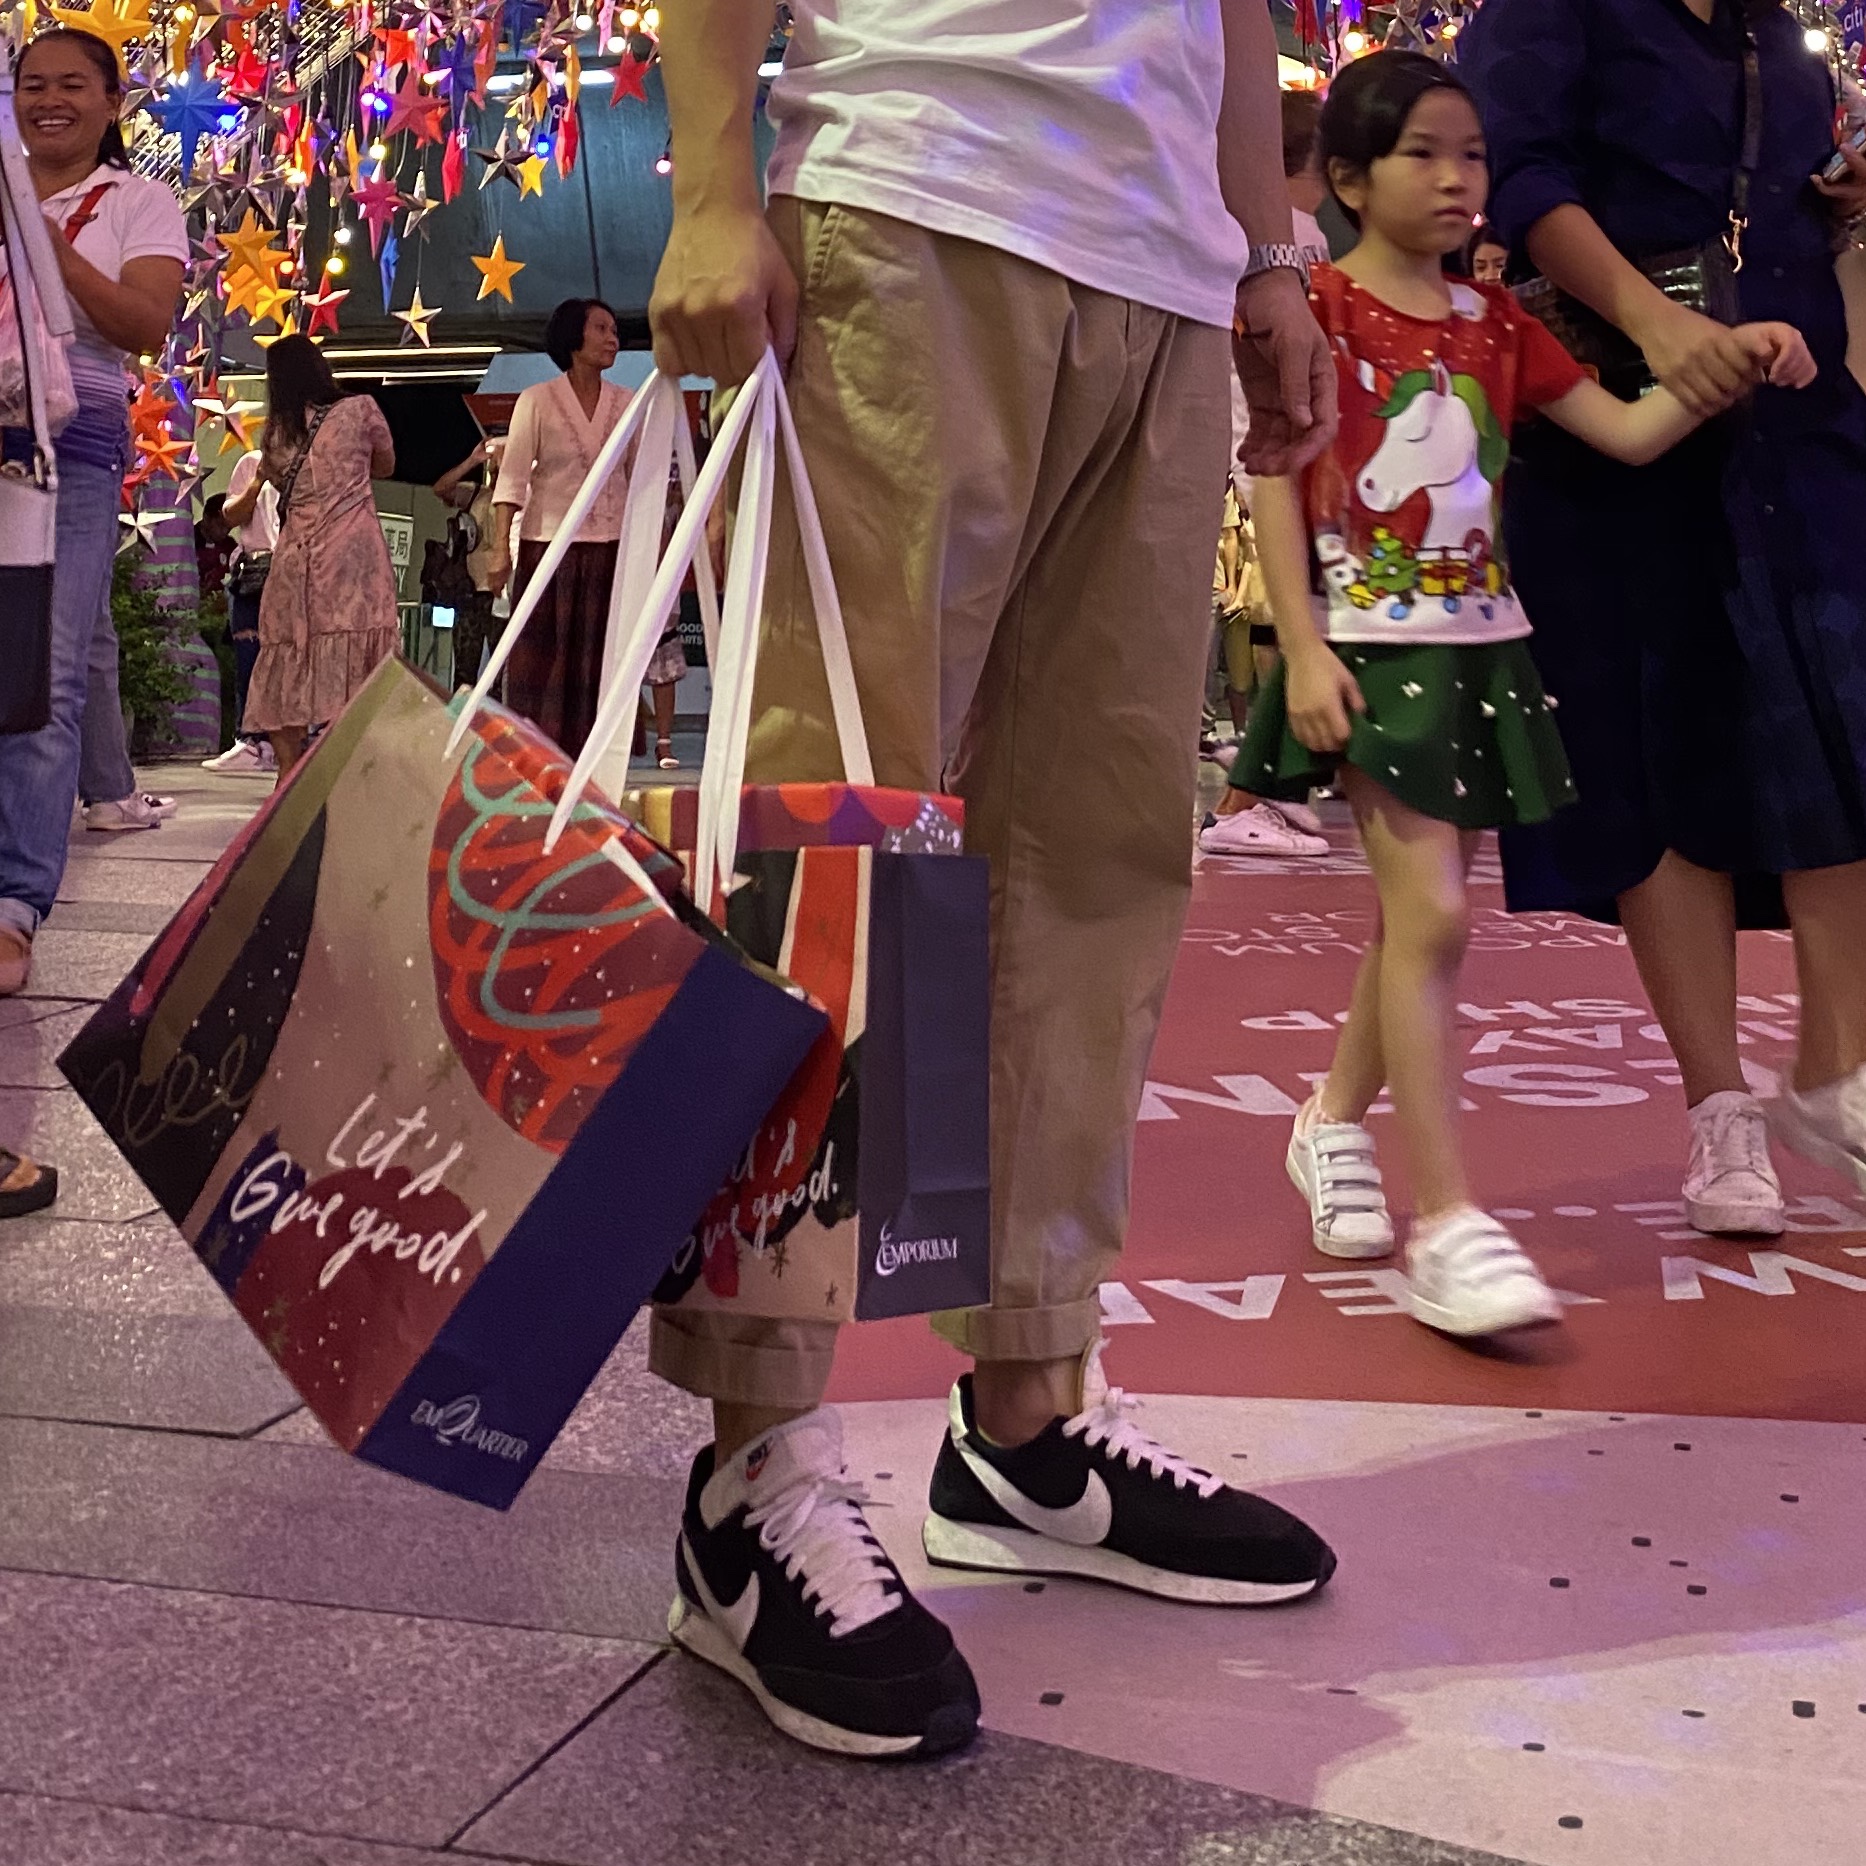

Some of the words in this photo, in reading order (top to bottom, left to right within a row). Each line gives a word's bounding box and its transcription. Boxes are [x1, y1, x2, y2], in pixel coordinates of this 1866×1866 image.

[326, 1093, 463, 1198] Let's
[230, 1152, 344, 1237] Give
[319, 1209, 487, 1288] good.
[875, 1216, 958, 1276] EMPORIUM
